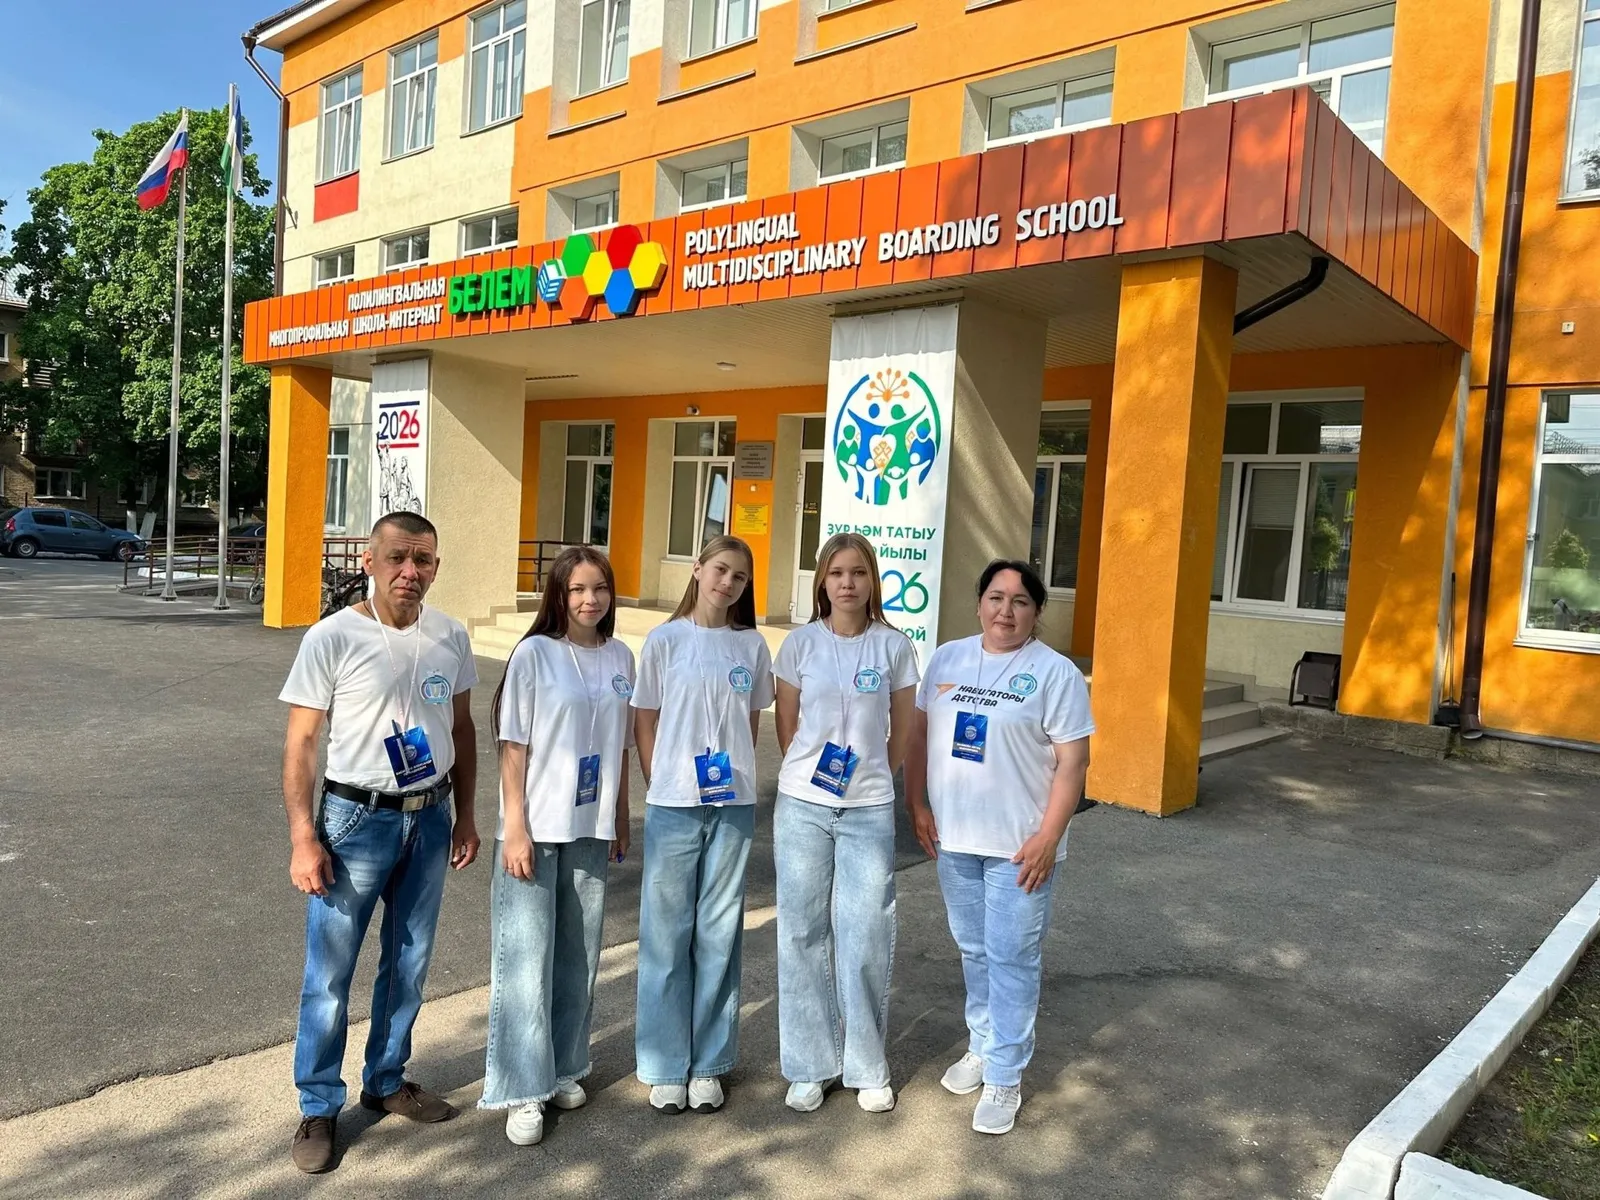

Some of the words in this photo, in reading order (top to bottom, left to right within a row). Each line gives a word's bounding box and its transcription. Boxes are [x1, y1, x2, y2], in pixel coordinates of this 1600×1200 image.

[683, 236, 867, 290] MULTIDISCIPLINARY
[878, 213, 1002, 262] BOARDING
[1015, 194, 1124, 241] SCHOOL
[684, 212, 799, 256] POLYLINGUAL
[348, 276, 445, 313] ПОЛИЛИНГВАЛЬНАЯ
[448, 266, 536, 315] БЕЛЕМ
[269, 320, 349, 347] МНОГОПРОФИЛЬНАЯ
[353, 303, 443, 336] ШКОЛА-ИНТЕРНАТ
[378, 409, 420, 440] 2026
[886, 526, 936, 540] ТАТЫУ
[881, 569, 929, 614] 26
